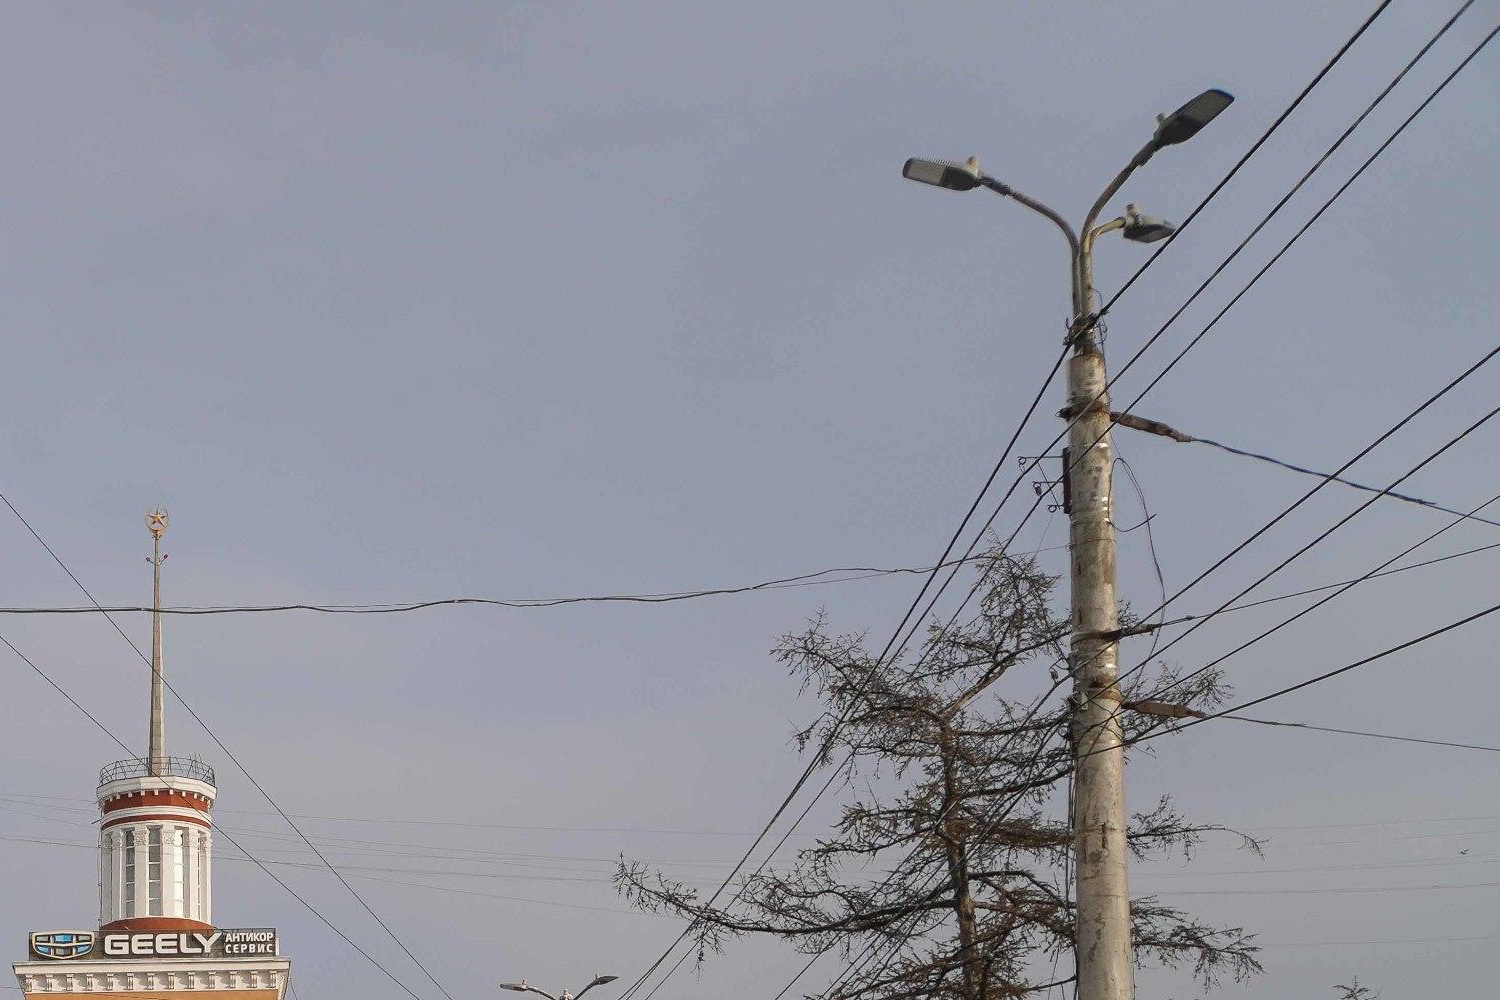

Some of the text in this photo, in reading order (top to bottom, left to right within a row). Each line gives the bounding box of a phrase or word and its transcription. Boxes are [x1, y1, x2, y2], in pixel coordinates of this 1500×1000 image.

[225, 932, 274, 943] АНТИКОР
[104, 932, 223, 955] GEELY
[225, 943, 274, 954] СЕРВИС
